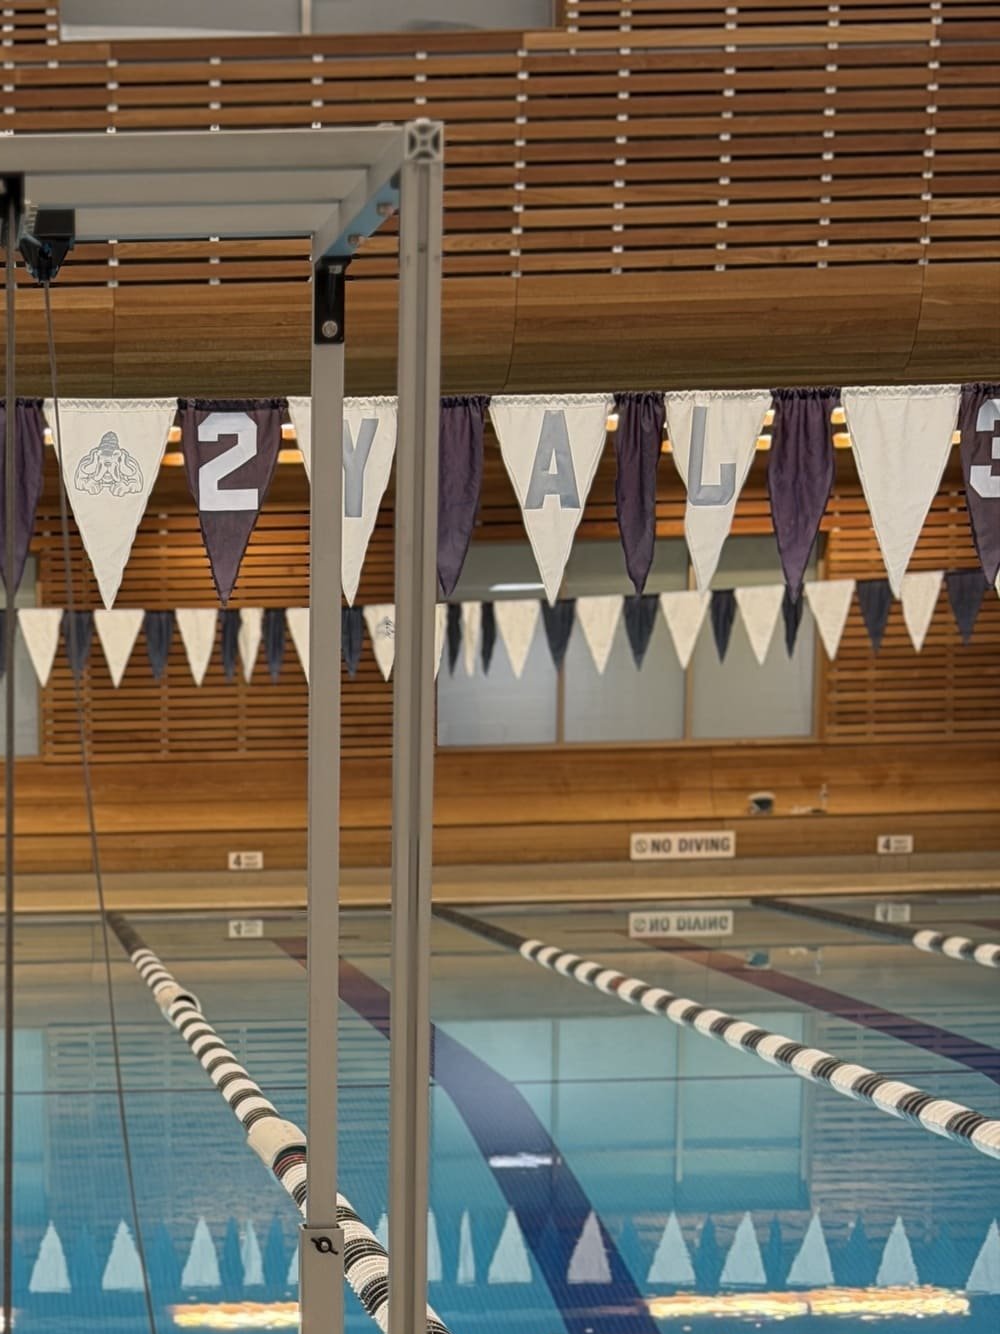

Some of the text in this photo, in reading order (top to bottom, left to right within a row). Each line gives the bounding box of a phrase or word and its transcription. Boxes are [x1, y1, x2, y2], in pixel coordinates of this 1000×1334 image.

[198, 412, 258, 511] 2
[342, 418, 379, 518] Y
[524, 409, 581, 510] A
[651, 837, 730, 852] NO DIVING
